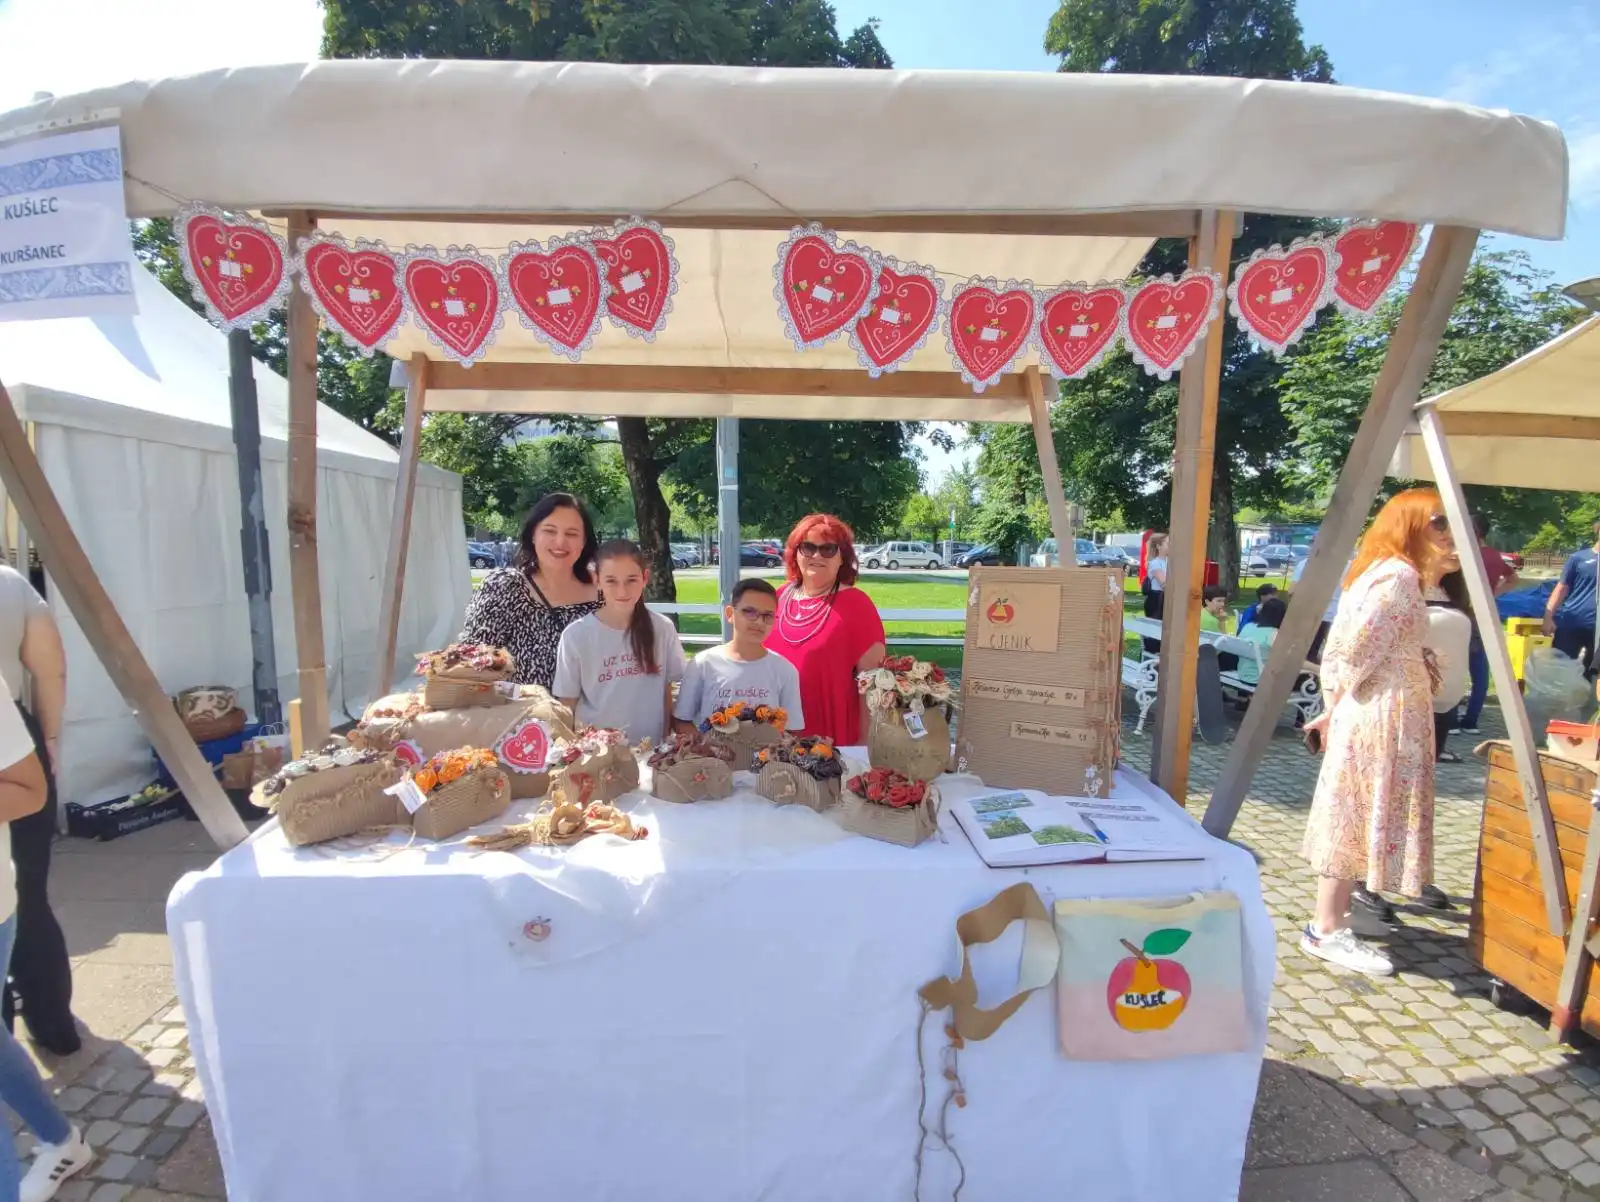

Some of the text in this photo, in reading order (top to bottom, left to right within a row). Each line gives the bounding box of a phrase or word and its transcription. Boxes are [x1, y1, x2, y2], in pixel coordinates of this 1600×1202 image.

[4, 196, 59, 220] KUŠLEC
[0, 244, 66, 264] KURŠANEC
[989, 633, 1033, 649] CJENIK
